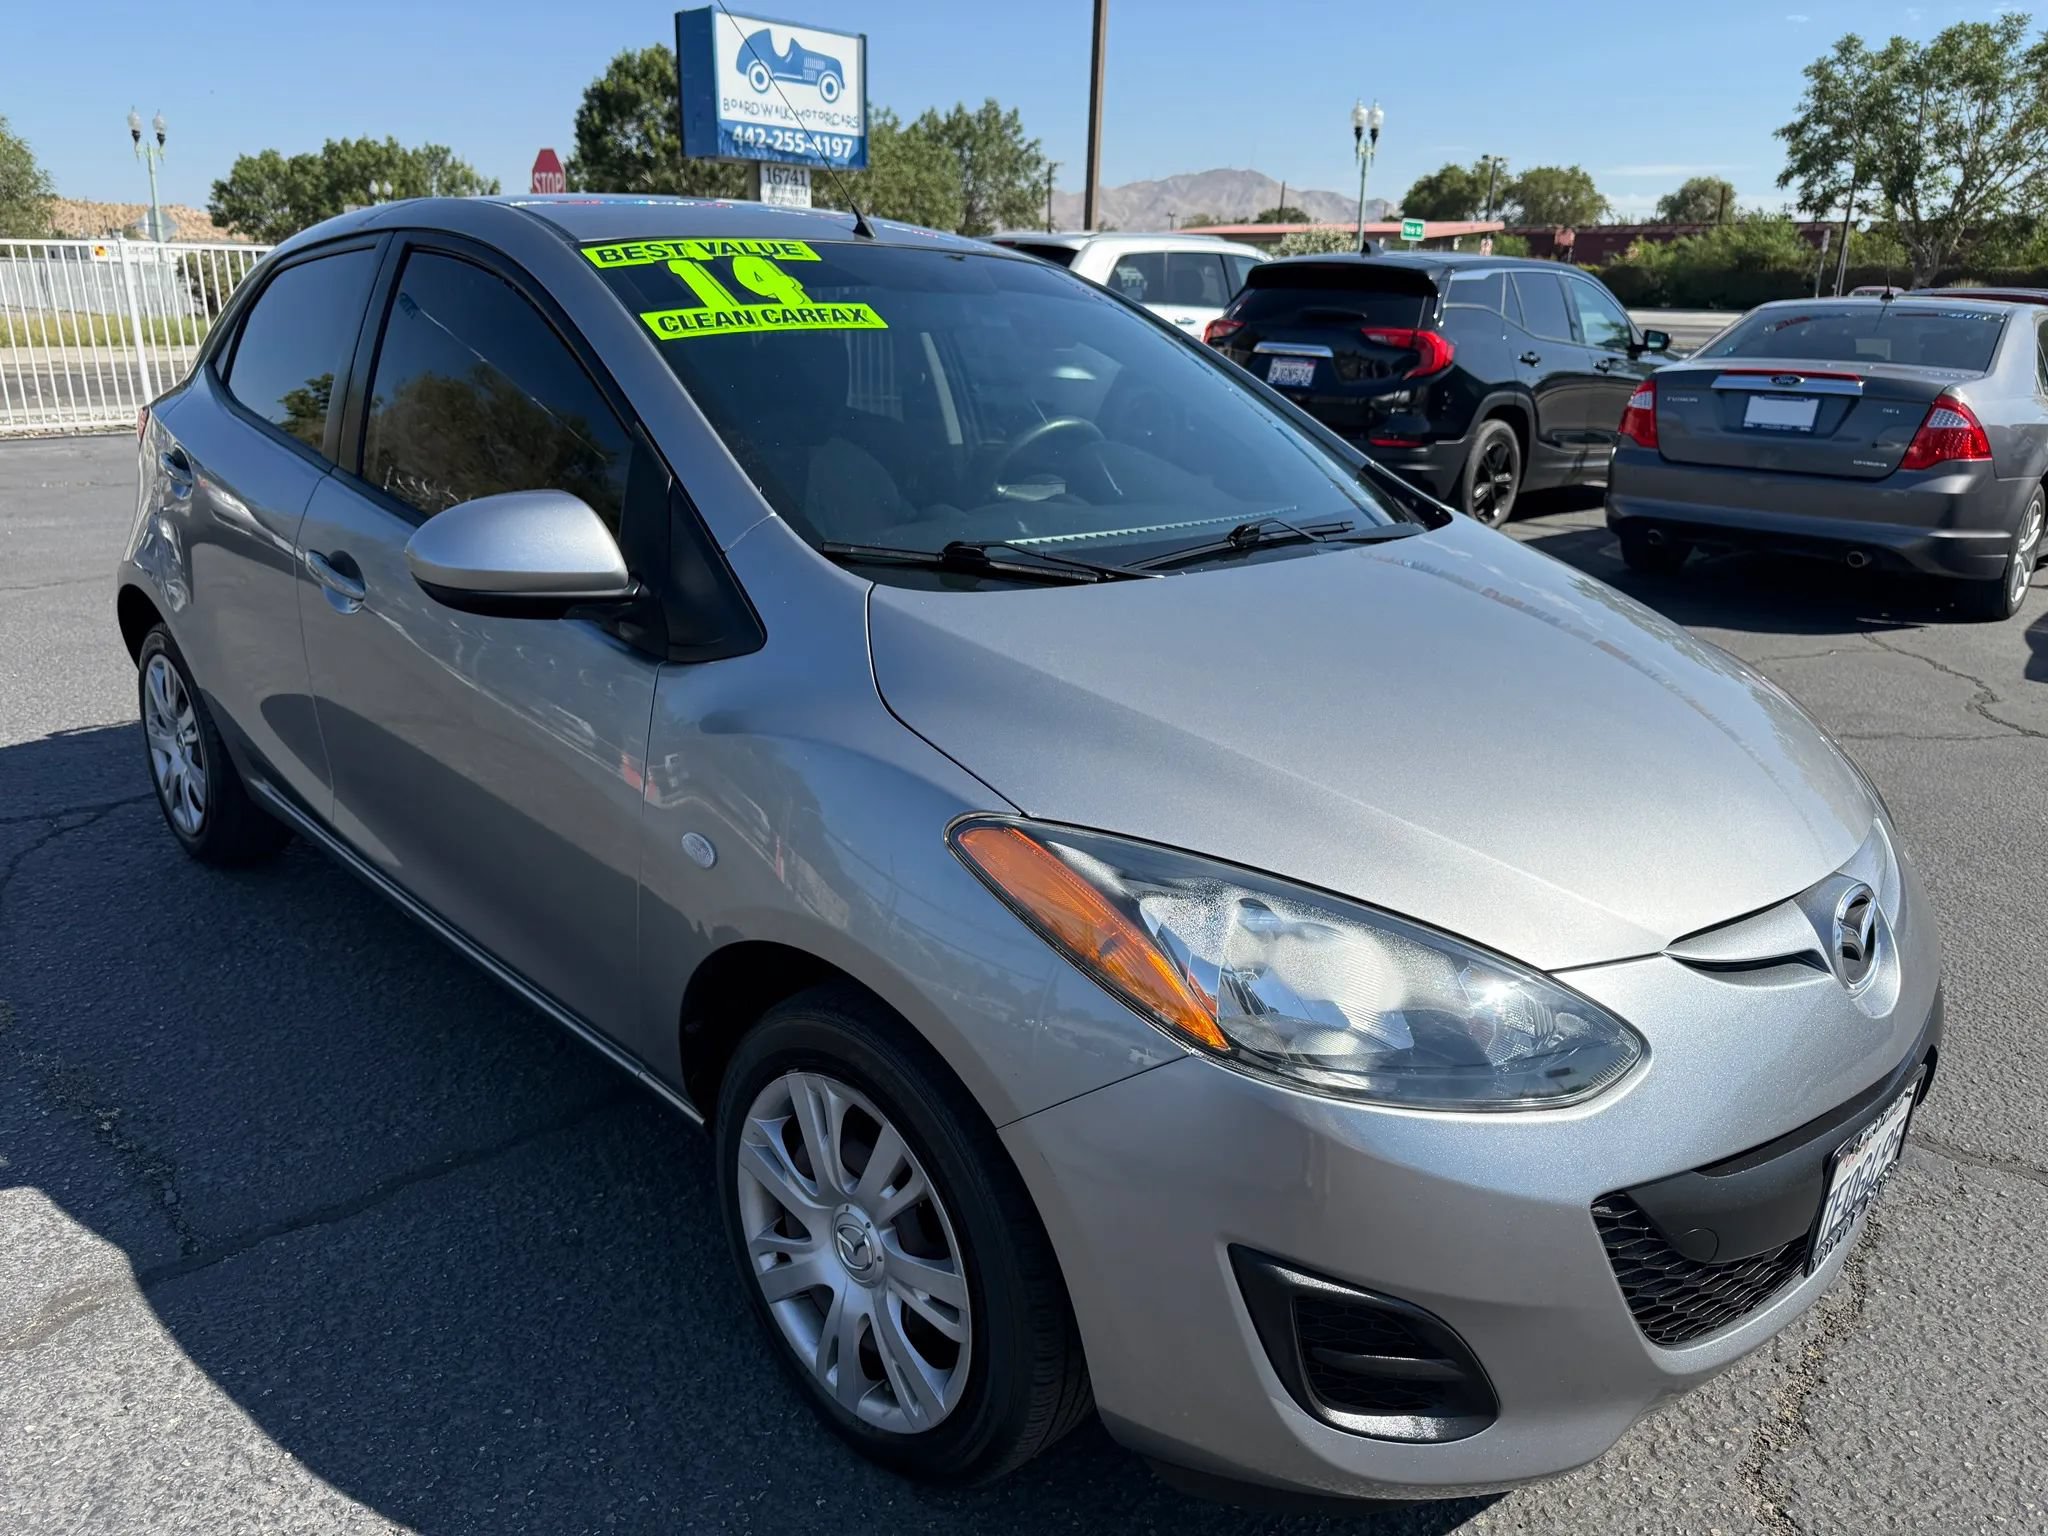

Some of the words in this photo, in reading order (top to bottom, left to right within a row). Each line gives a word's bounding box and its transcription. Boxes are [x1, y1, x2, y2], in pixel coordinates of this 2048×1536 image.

[733, 125, 853, 158] 442-255-4197
[534, 172, 562, 193] STOP
[766, 167, 806, 187] 16741
[595, 242, 685, 263] BEST
[699, 241, 803, 257] VALUE
[668, 255, 813, 306] 14
[657, 309, 759, 333] CLEAN
[761, 307, 869, 324] CARFAX
